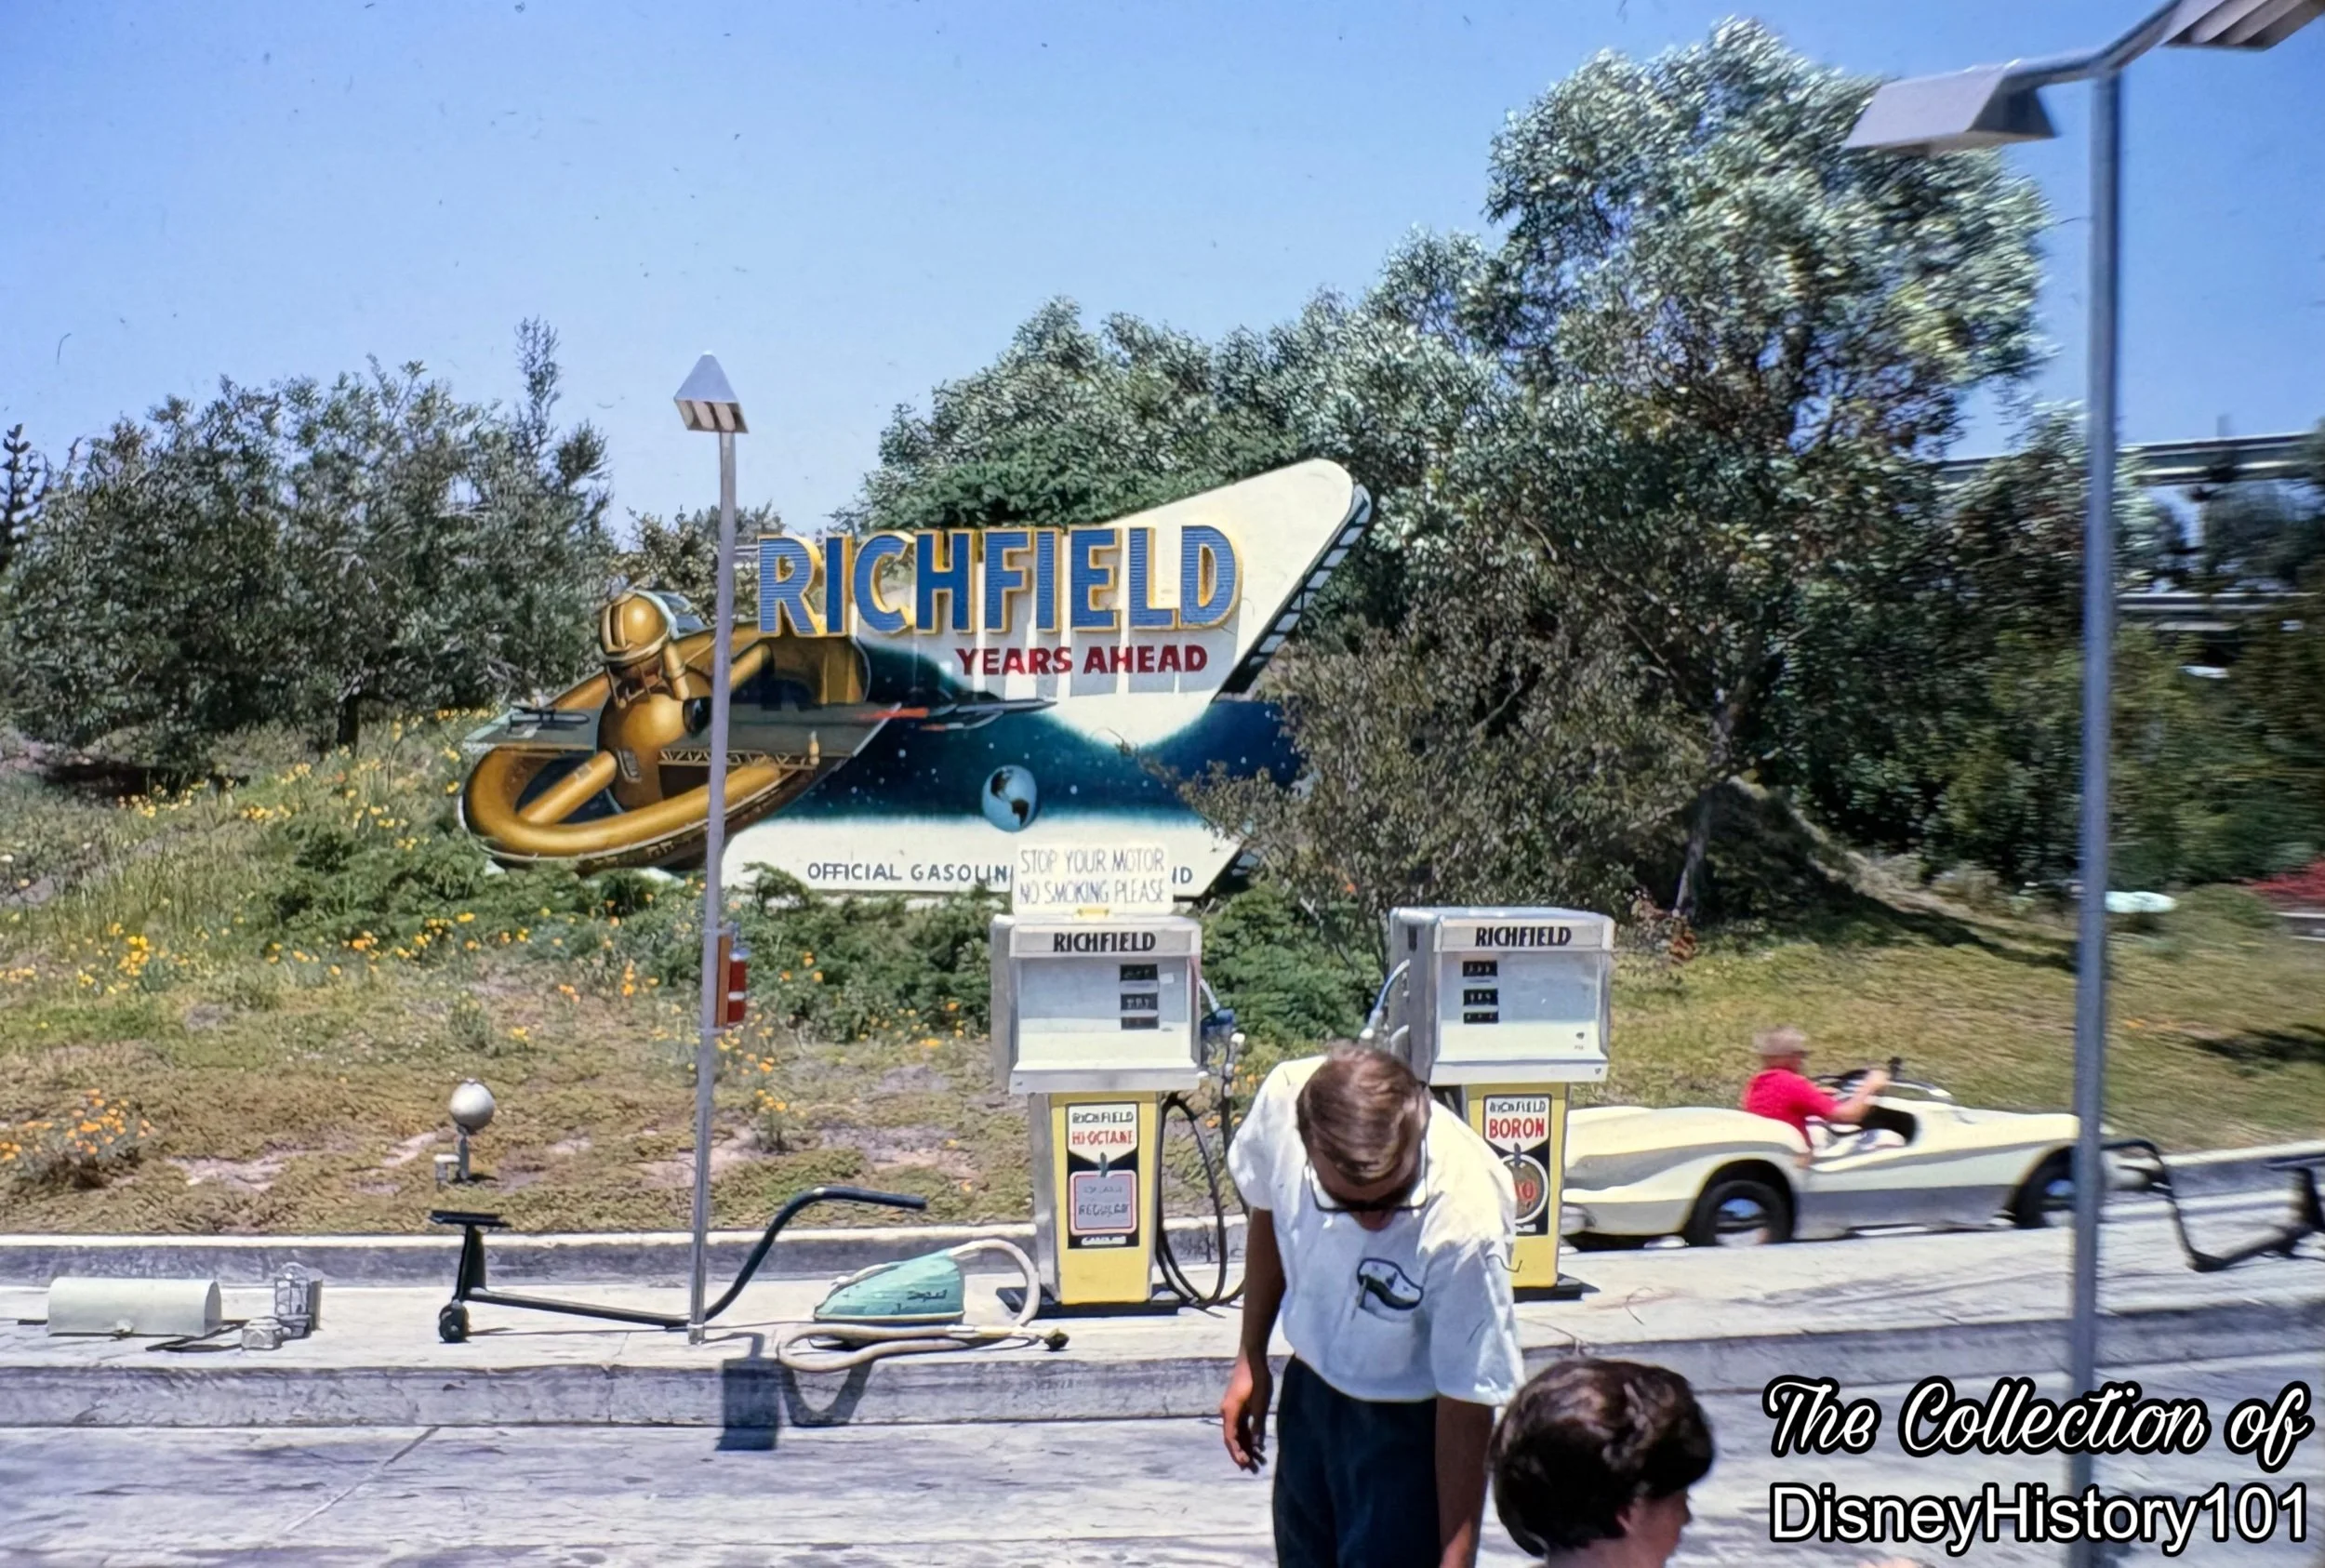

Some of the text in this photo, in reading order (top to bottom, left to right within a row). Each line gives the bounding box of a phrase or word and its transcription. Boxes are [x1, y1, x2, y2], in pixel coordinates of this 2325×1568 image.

[757, 525, 1242, 637] RICHFIELD
[955, 644, 1208, 676] YEARS AHEAD
[807, 861, 1014, 884] OFFICIAL GASOLIN
[1020, 847, 1164, 874] STOP YOUR MOTOR
[1019, 878, 1164, 904] NO SMOKING PLEASE
[1053, 931, 1156, 952] RICHFIELD
[1475, 926, 1572, 947] RICHFIELD
[1489, 1118, 1545, 1138] BORON
